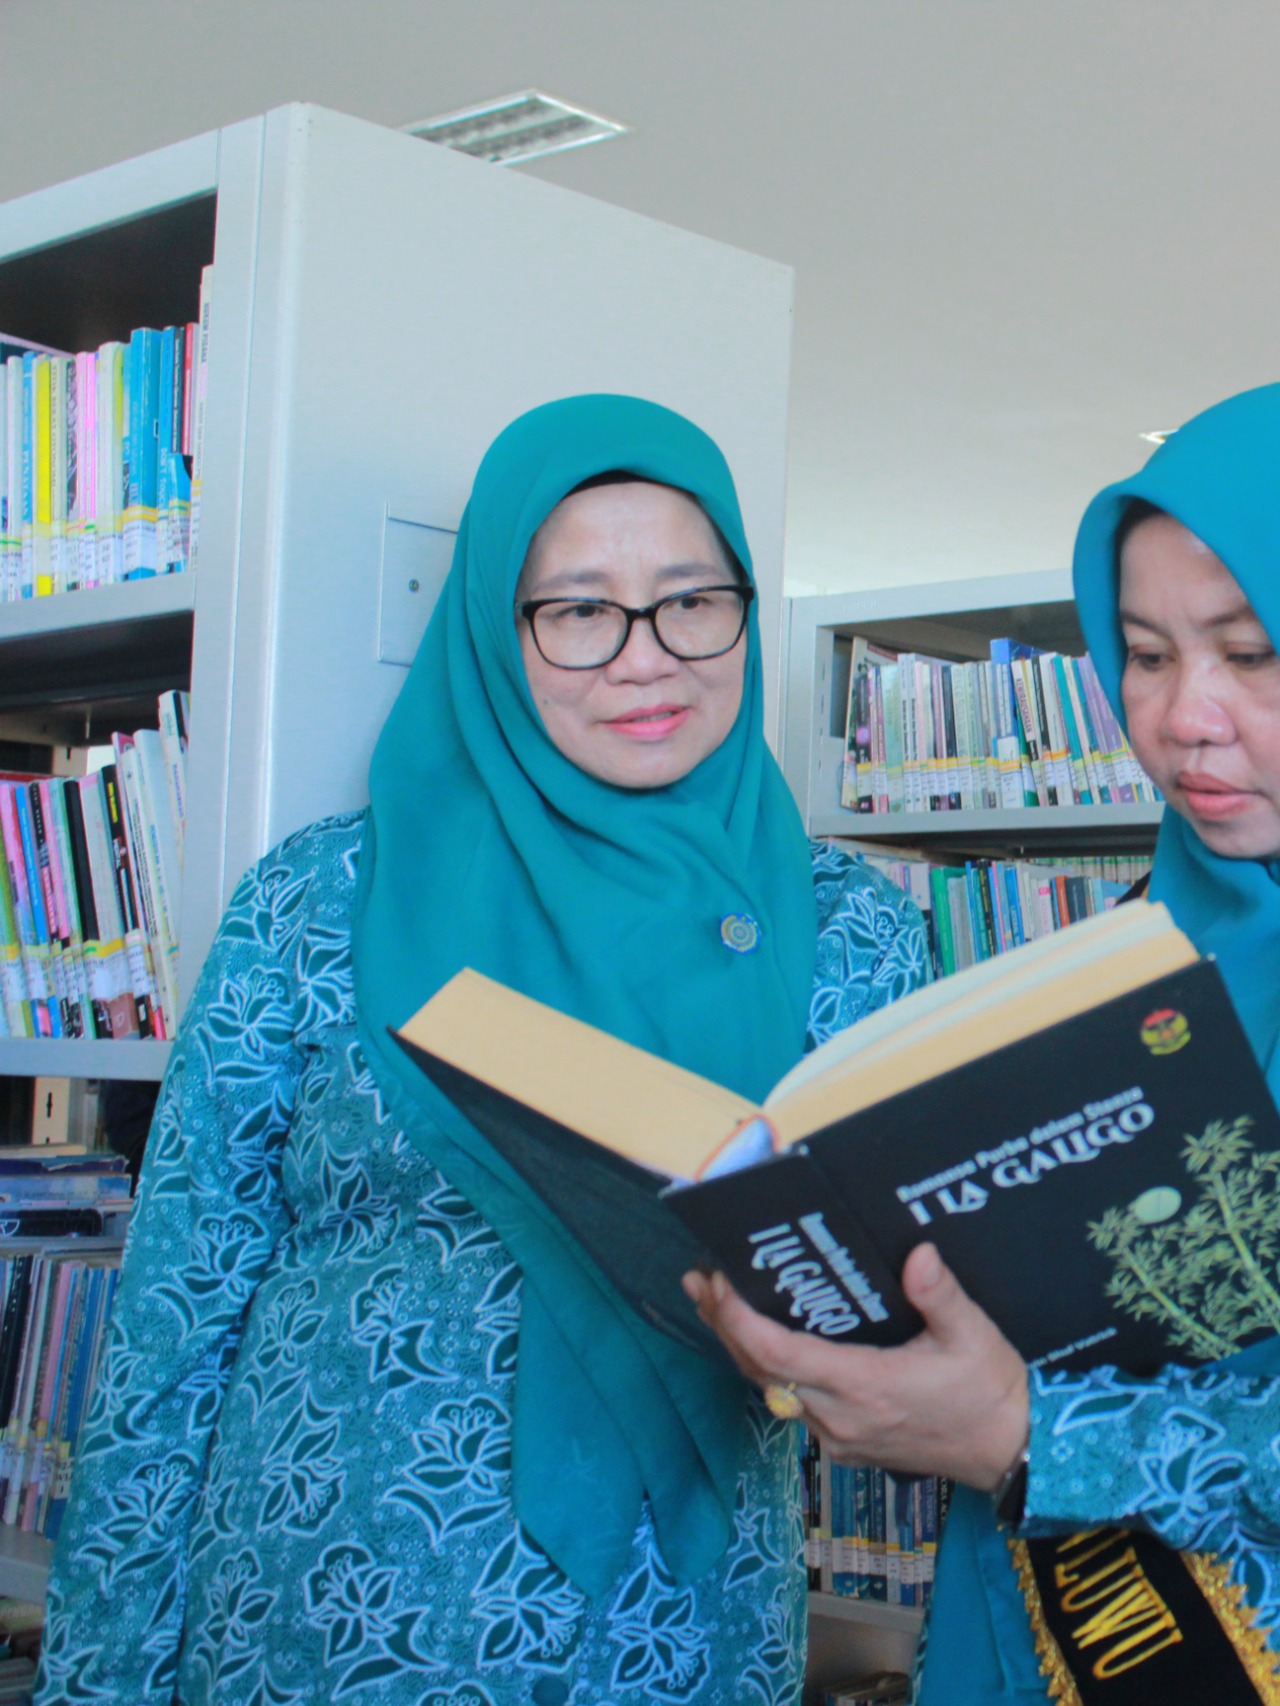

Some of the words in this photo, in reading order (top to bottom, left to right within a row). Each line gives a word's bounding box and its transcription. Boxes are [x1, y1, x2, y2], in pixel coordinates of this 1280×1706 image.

[908, 1199, 933, 1226] I
[936, 1179, 990, 1214] LA
[992, 1102, 1155, 1188] GALIGO
[1055, 1529, 1183, 1680] LUWU
